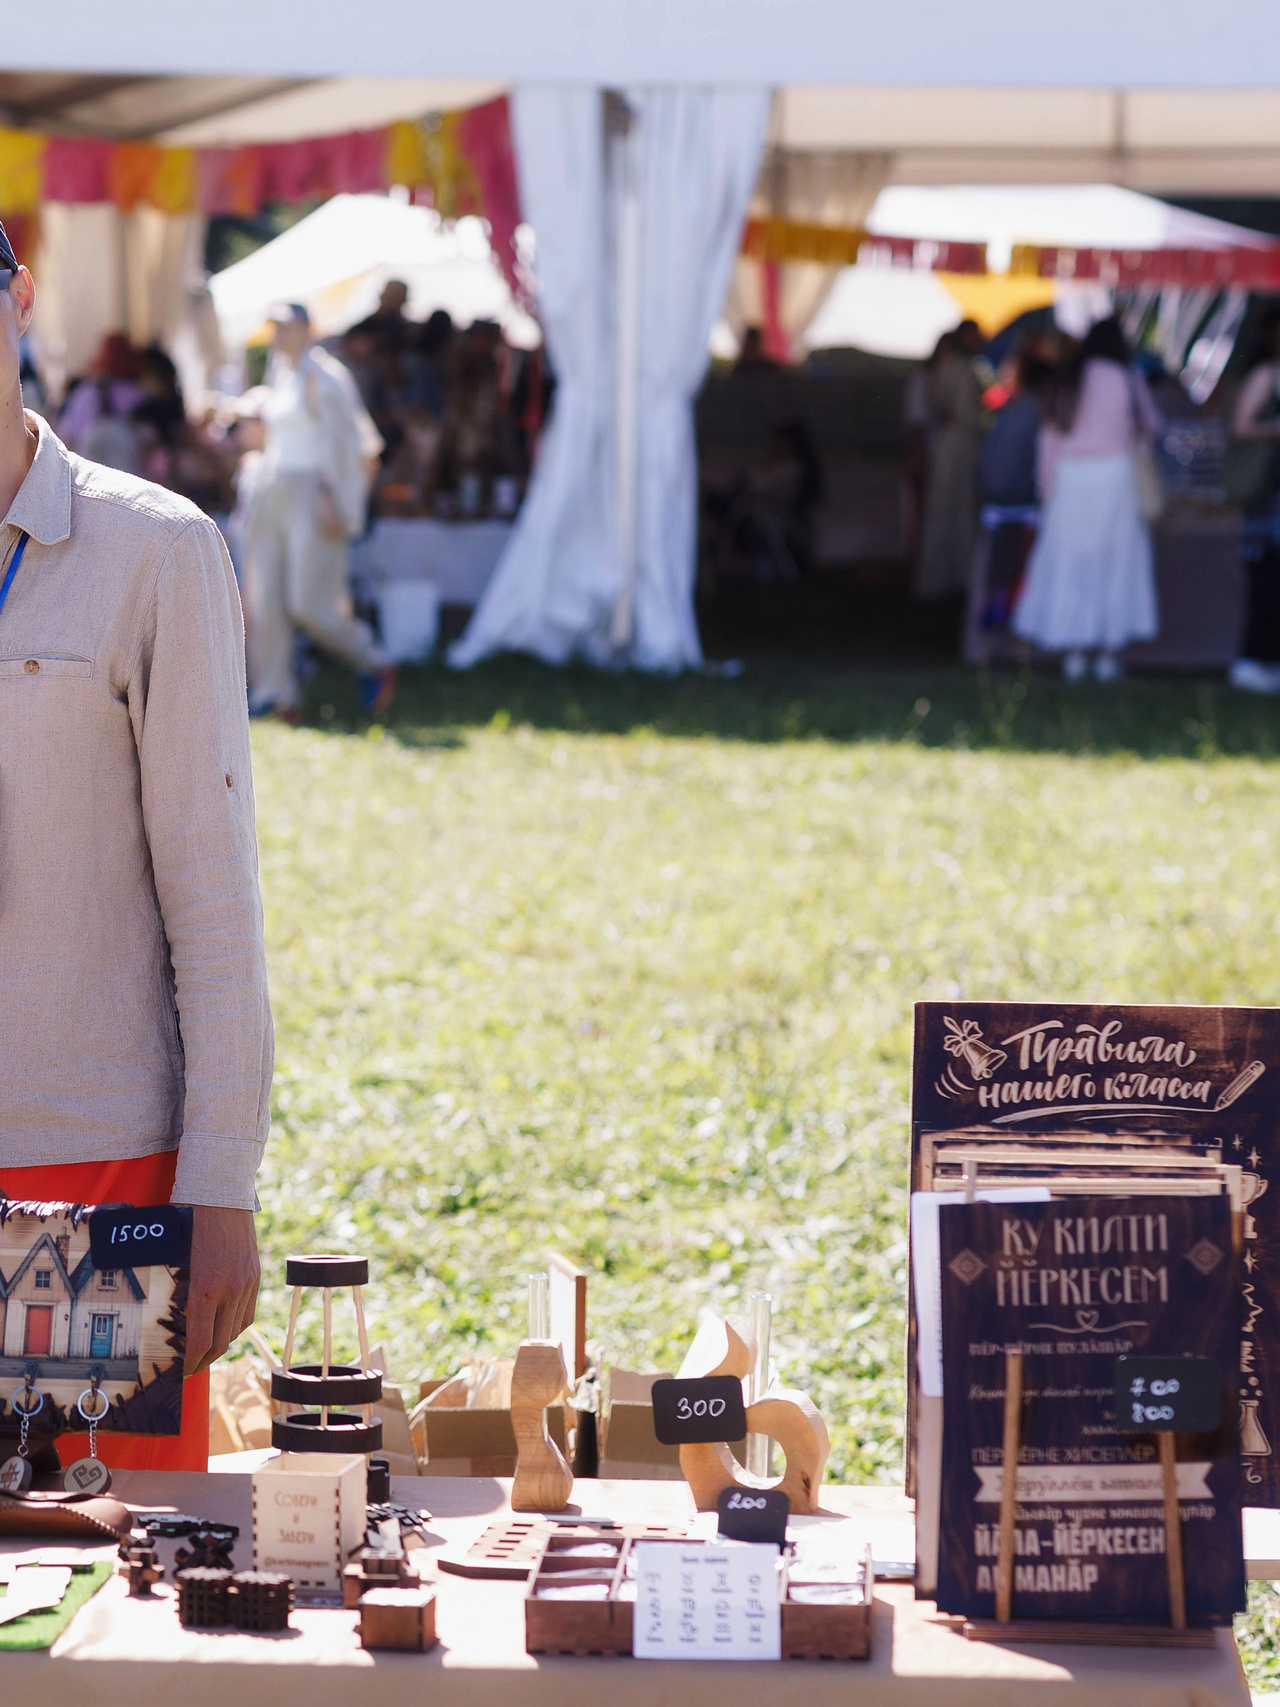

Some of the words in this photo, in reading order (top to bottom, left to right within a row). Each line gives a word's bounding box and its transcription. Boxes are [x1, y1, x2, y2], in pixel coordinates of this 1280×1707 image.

[1001, 1019, 1197, 1077] Правила
[978, 1071, 1097, 1108] нашего
[1104, 1072, 1212, 1103] класса
[111, 1223, 164, 1244] 1500
[1002, 1217, 1043, 1257] КУ
[677, 1397, 727, 1420] 300
[1131, 1402, 1175, 1423] 800
[727, 1492, 767, 1510] 200
